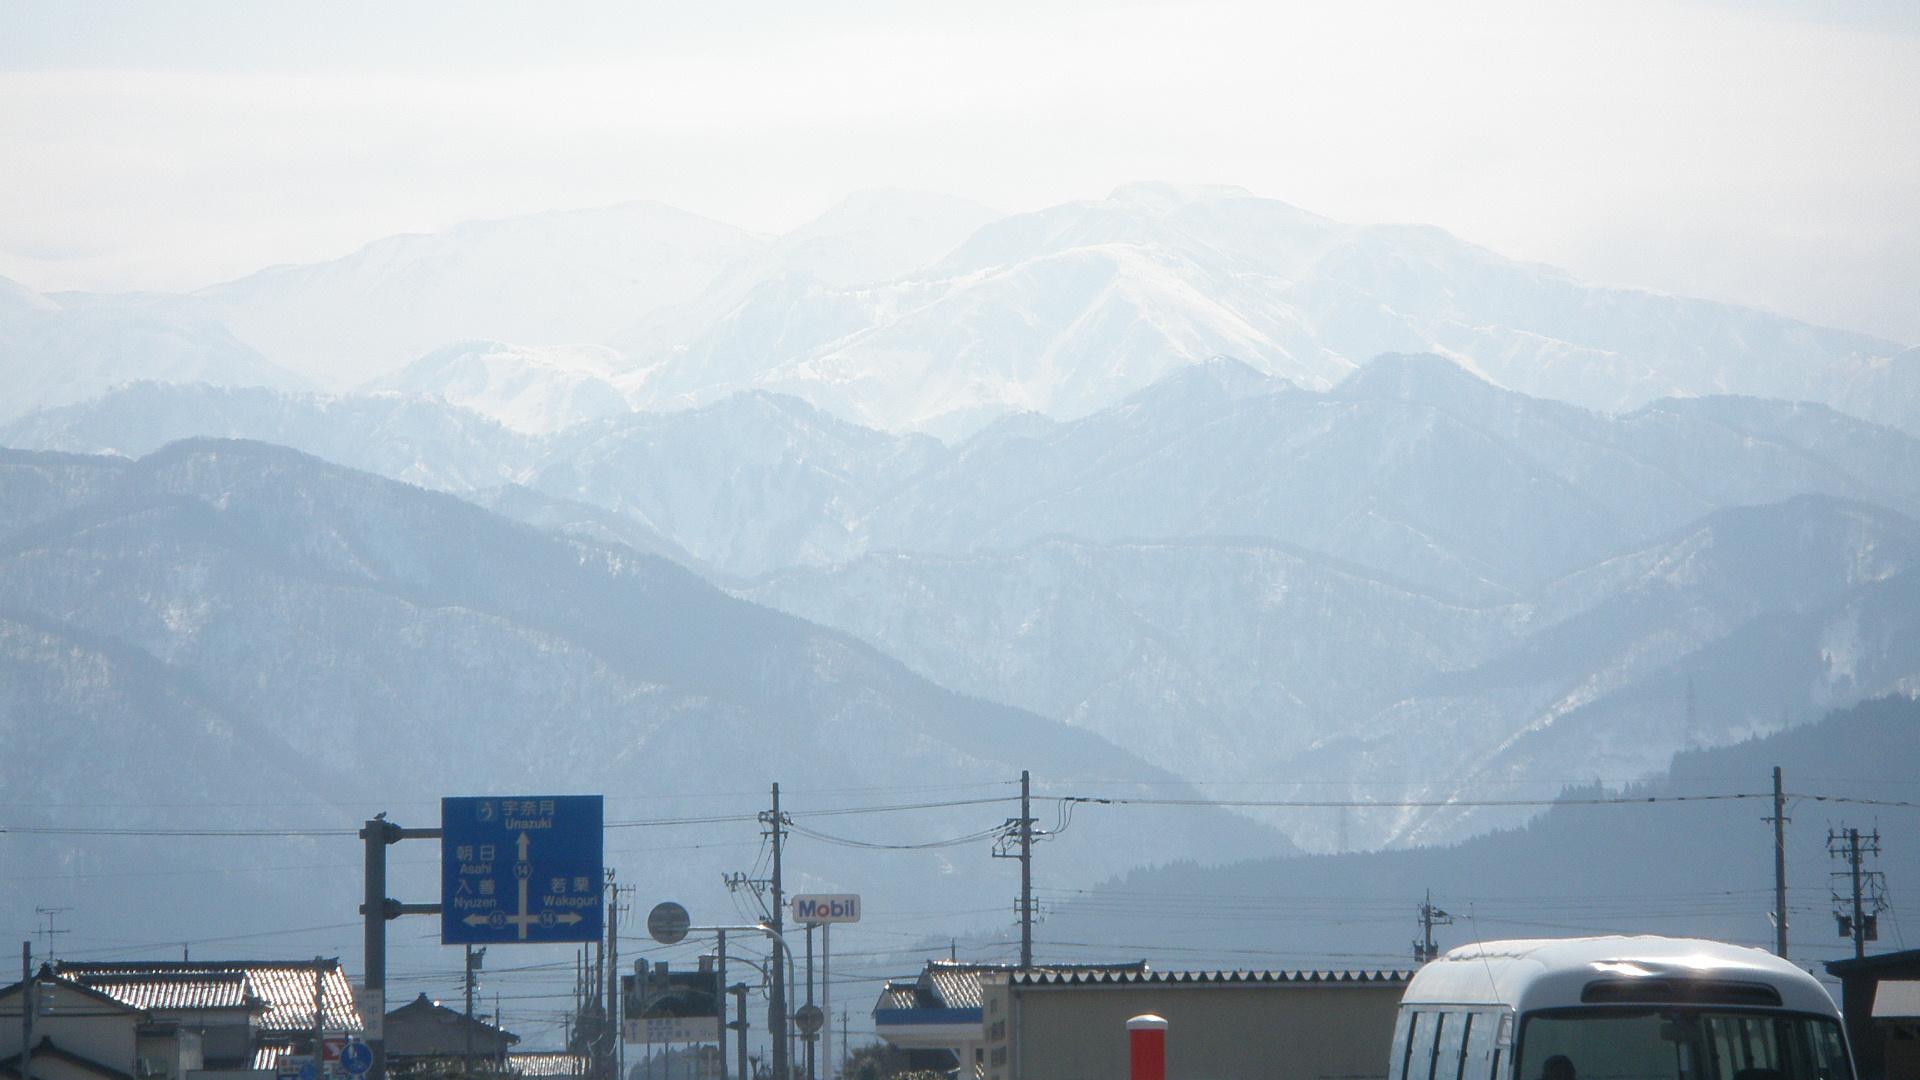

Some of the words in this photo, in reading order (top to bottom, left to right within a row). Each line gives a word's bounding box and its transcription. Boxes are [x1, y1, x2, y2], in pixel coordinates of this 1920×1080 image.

[502, 800, 555, 815] 宇奈月
[506, 818, 551, 829] Unazuki
[457, 846, 495, 861] 朝日
[460, 863, 492, 874] Asahi
[551, 878, 589, 893] 若栗
[454, 897, 497, 909] Nyuzen
[544, 895, 598, 908] Wakaguri
[799, 900, 855, 917] Mobil
